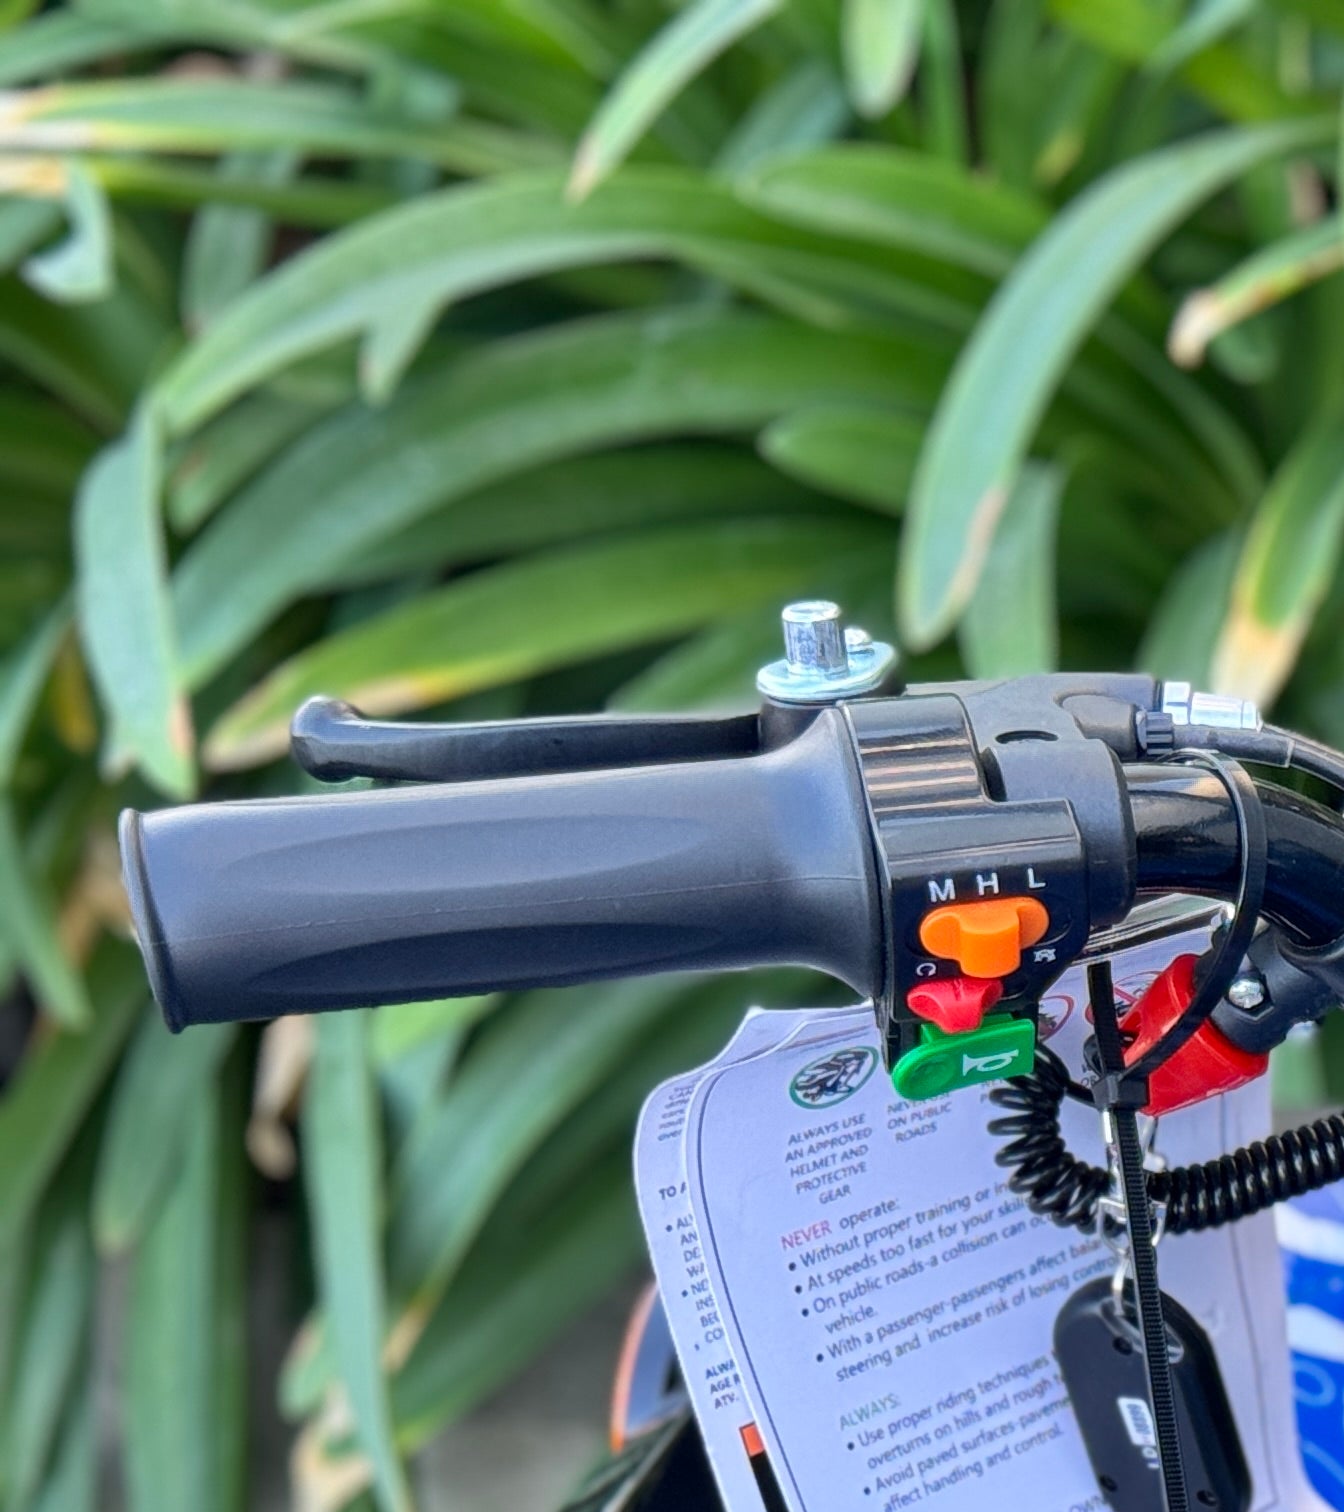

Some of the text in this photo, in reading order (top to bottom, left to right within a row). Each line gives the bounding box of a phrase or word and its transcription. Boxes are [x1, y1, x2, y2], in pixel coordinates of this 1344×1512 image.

[928, 868, 1046, 902] M H L
[788, 1114, 865, 1146] ALWAYS USE
[887, 1102, 952, 1130] ON PUBLIC
[896, 1122, 937, 1143] ROADS
[785, 1127, 872, 1163] AN APPROVED
[790, 1144, 868, 1178] HELMET AND
[796, 1161, 867, 1195] PROTECTIVE
[819, 1184, 851, 1205] GEAR
[780, 1219, 832, 1250] NEVER
[799, 1189, 990, 1268] Without proper training or
[807, 1273, 825, 1292] At
[827, 1253, 878, 1286] speeds
[880, 1244, 905, 1263] too
[908, 1231, 936, 1252] fast
[938, 1221, 958, 1241] for
[961, 1211, 995, 1234] your
[813, 1296, 837, 1314] On
[839, 1276, 883, 1307] public
[941, 1231, 998, 1263] collision
[1002, 1221, 1027, 1240] can
[826, 1334, 862, 1360] With
[865, 1331, 874, 1345] a
[1030, 1249, 1067, 1276] affect
[836, 1348, 893, 1382] steering
[895, 1333, 921, 1358] and
[927, 1310, 982, 1343] increase
[985, 1299, 1009, 1320] risk
[1012, 1287, 1027, 1307] of
[1028, 1274, 1070, 1299] losing
[857, 1428, 885, 1448] Use
[888, 1407, 933, 1437] proper
[936, 1388, 977, 1413] riding
[977, 1354, 1049, 1396] techniques
[867, 1434, 932, 1470] overturns
[934, 1424, 952, 1441] on
[954, 1409, 982, 1431] hills
[985, 1396, 1011, 1418] and
[1013, 1376, 1052, 1405] rough
[875, 1464, 915, 1493] Avoid
[917, 1447, 959, 1479] paved
[924, 1460, 984, 1494] handling
[986, 1445, 1012, 1468] and
